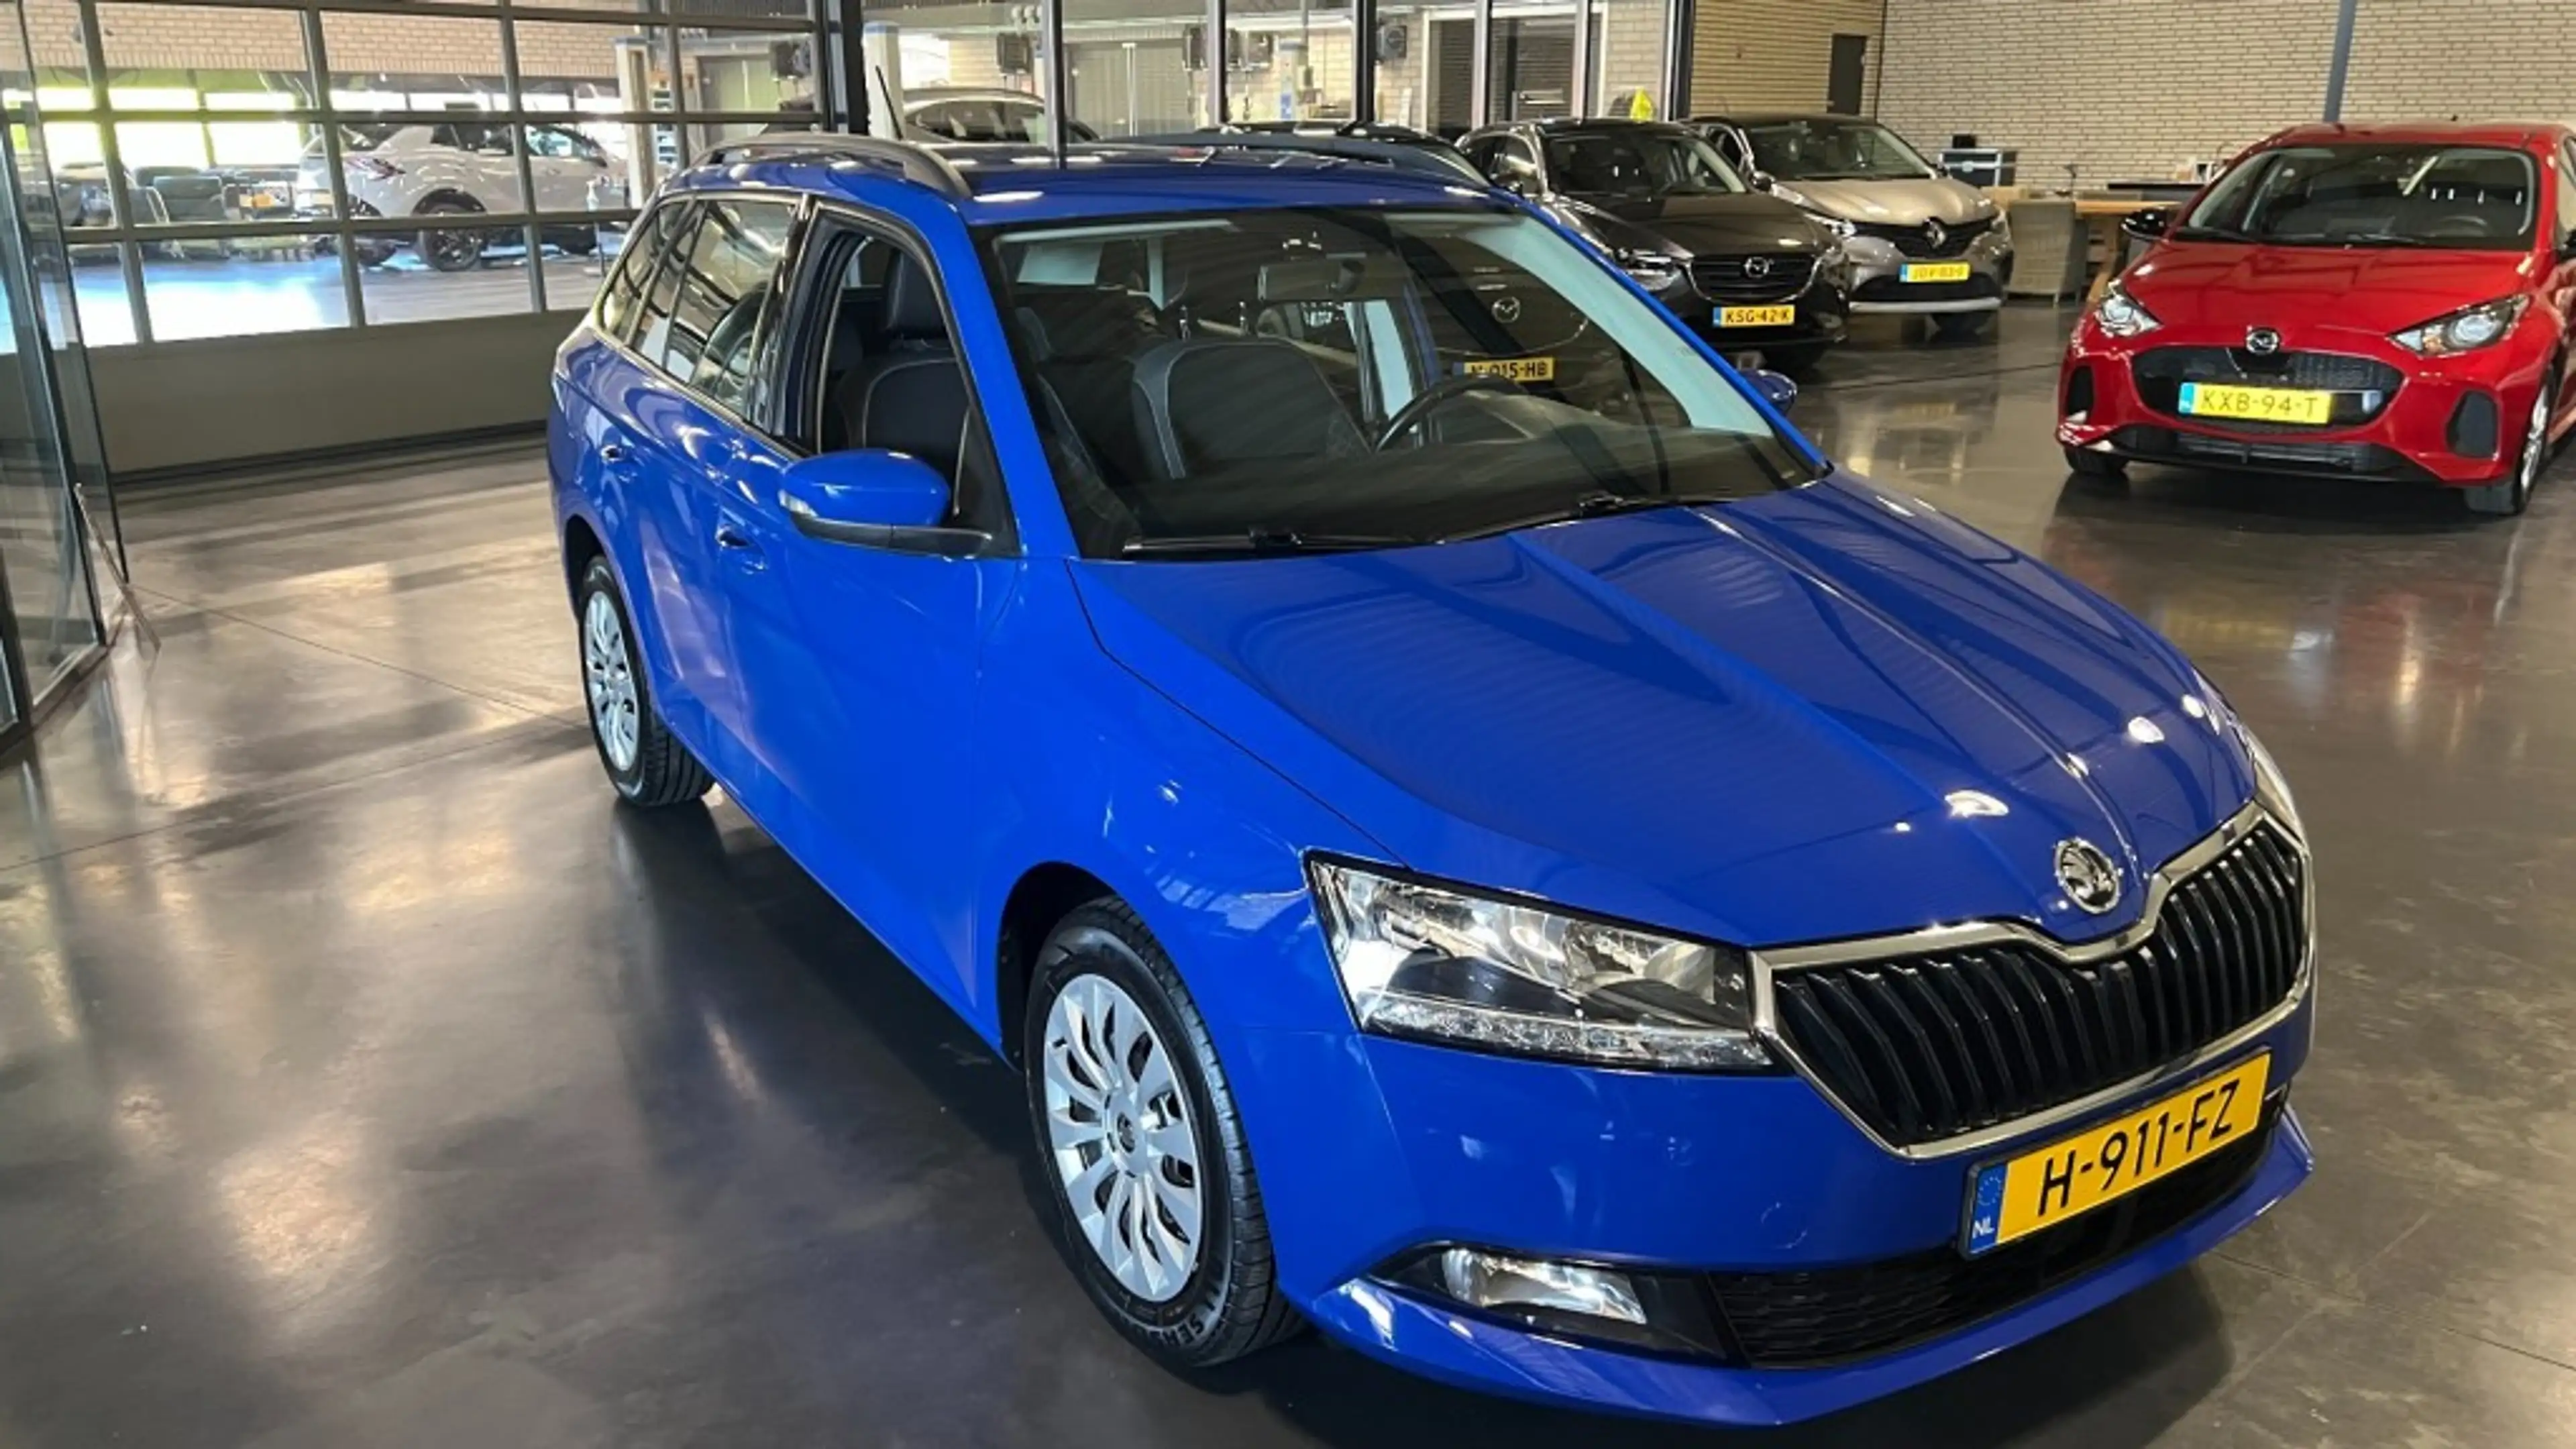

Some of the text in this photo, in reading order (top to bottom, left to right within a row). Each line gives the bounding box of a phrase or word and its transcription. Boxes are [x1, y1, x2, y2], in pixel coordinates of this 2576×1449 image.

[1726, 309, 1790, 323] KSG-42-K
[2200, 389, 2318, 417] KXB-94-T
[1972, 1078, 2241, 1239] NL H-911-FZ
